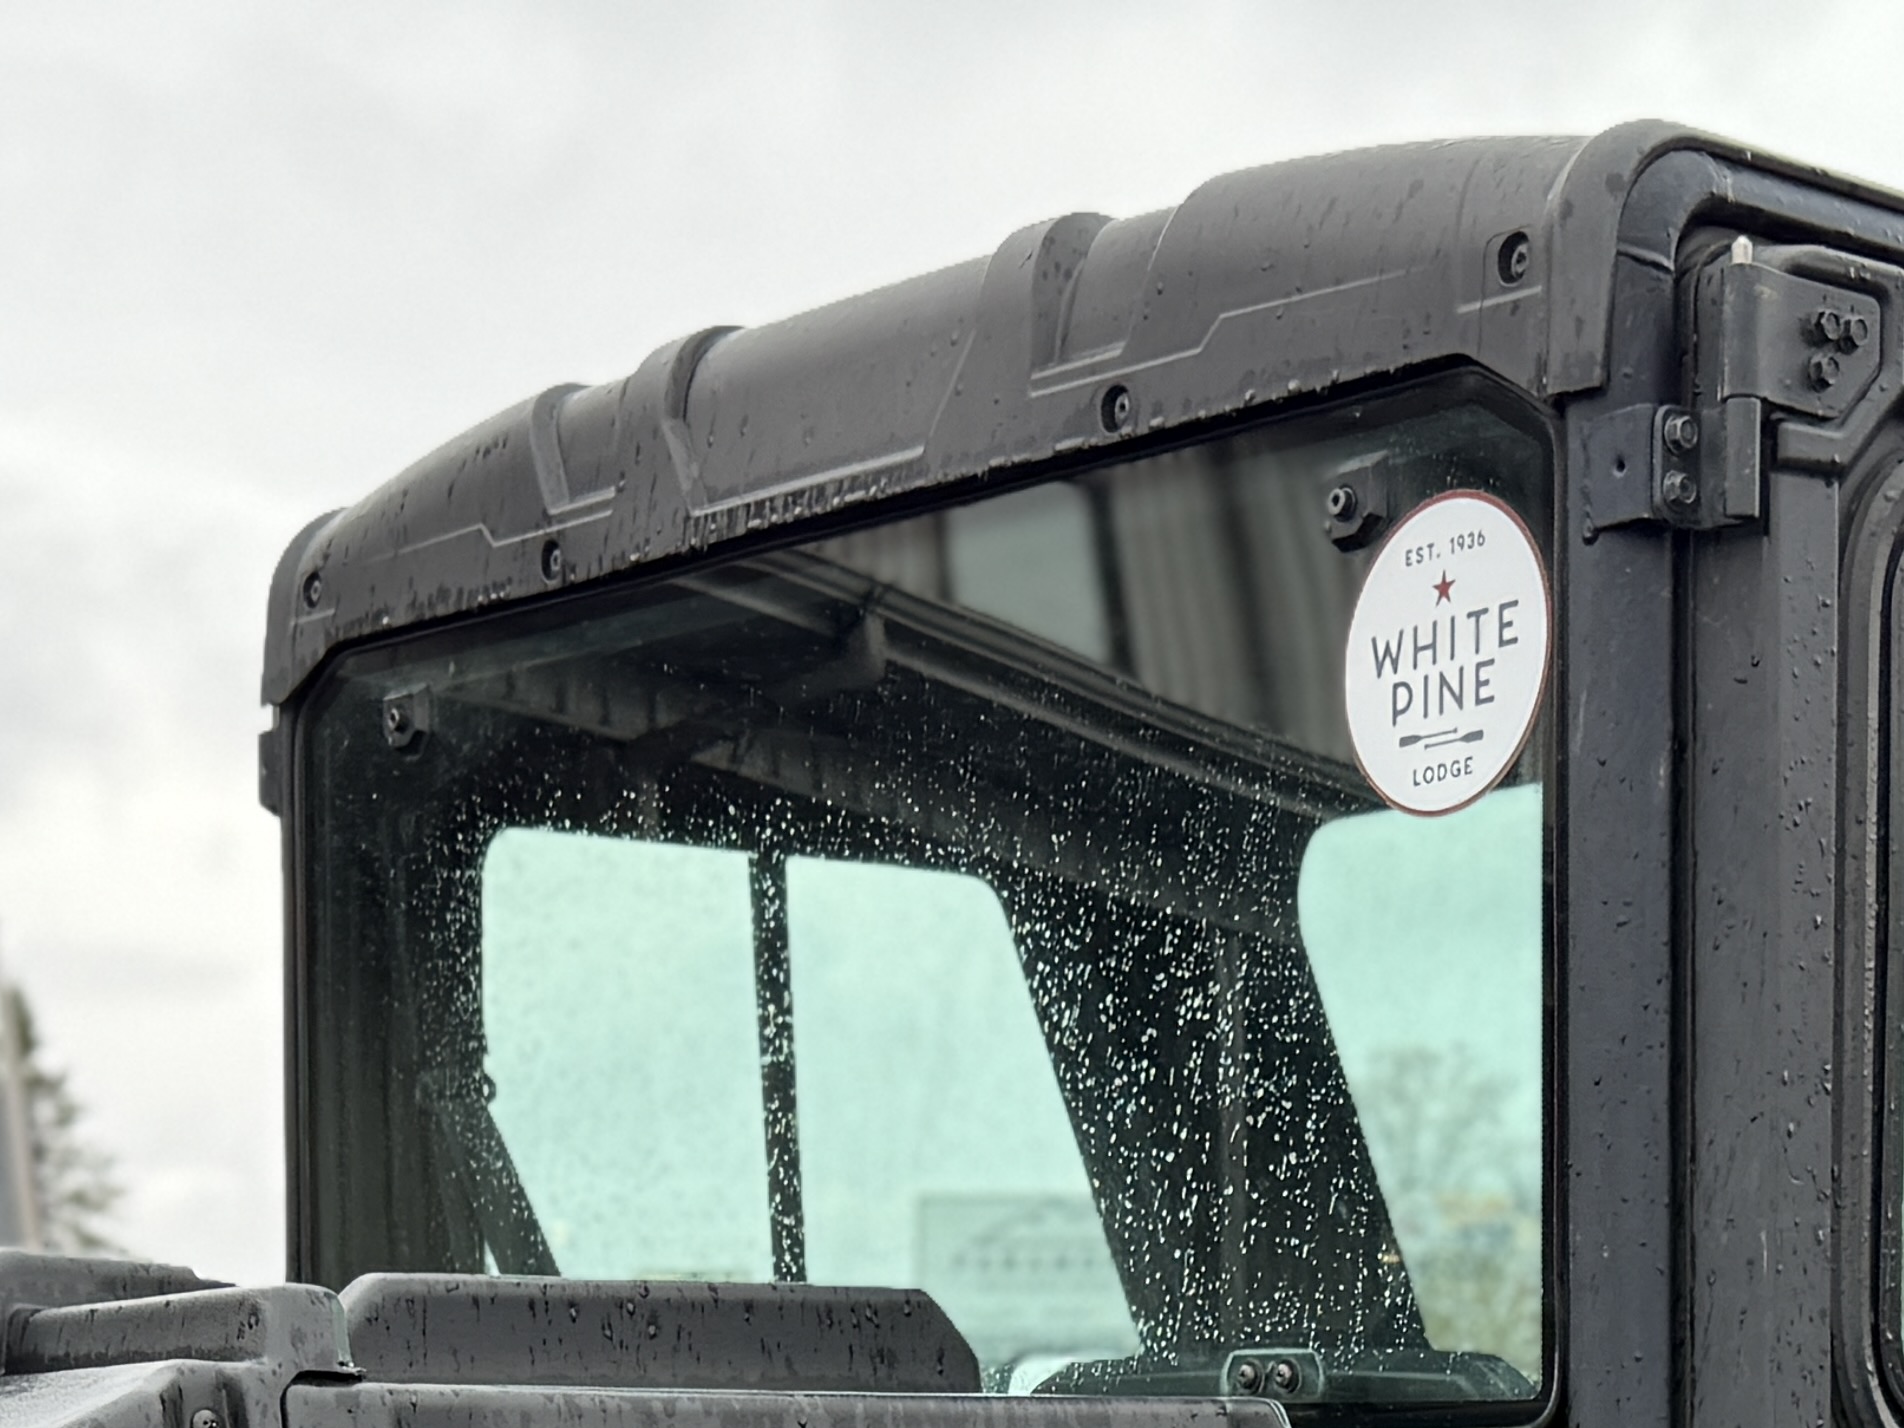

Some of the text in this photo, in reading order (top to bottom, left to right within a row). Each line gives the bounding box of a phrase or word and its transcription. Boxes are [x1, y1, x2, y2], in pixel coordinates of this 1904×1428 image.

[1404, 530, 1487, 568] EST. 1936
[1370, 599, 1520, 680] WHITE
[1391, 657, 1496, 728] PINE
[1412, 756, 1474, 787] LODGE
